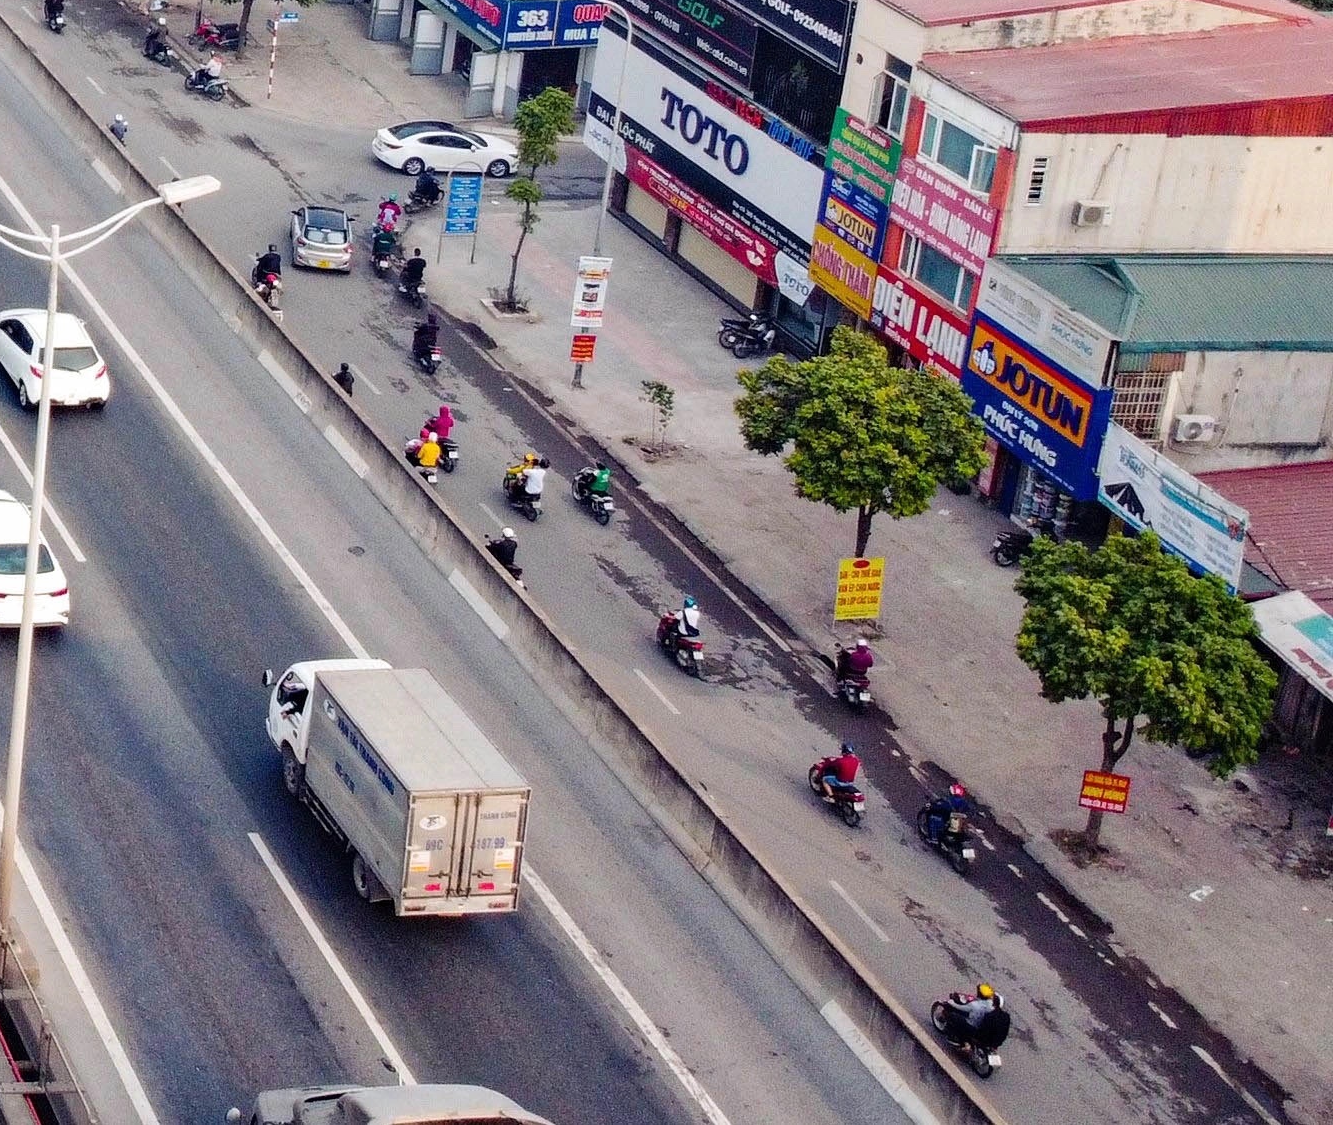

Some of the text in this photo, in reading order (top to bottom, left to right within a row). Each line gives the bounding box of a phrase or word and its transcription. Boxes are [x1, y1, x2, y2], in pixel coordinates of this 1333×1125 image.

[517, 9, 549, 27] 363
[564, 28, 587, 41] MUA
[619, 121, 635, 140] LỘC
[635, 133, 655, 154] PHÁT
[660, 86, 749, 176] TOTO
[915, 167, 934, 186] BÁN
[934, 178, 959, 201] BUÔN
[963, 197, 982, 216] BÁN
[837, 209, 873, 244] JOTUN
[783, 272, 810, 297] TOTO
[873, 274, 968, 369] ĐIỆN LẠNH
[996, 354, 1083, 436] JOTUN
[983, 404, 1019, 439] PHÚC
[1018, 429, 1057, 467] HƯNG
